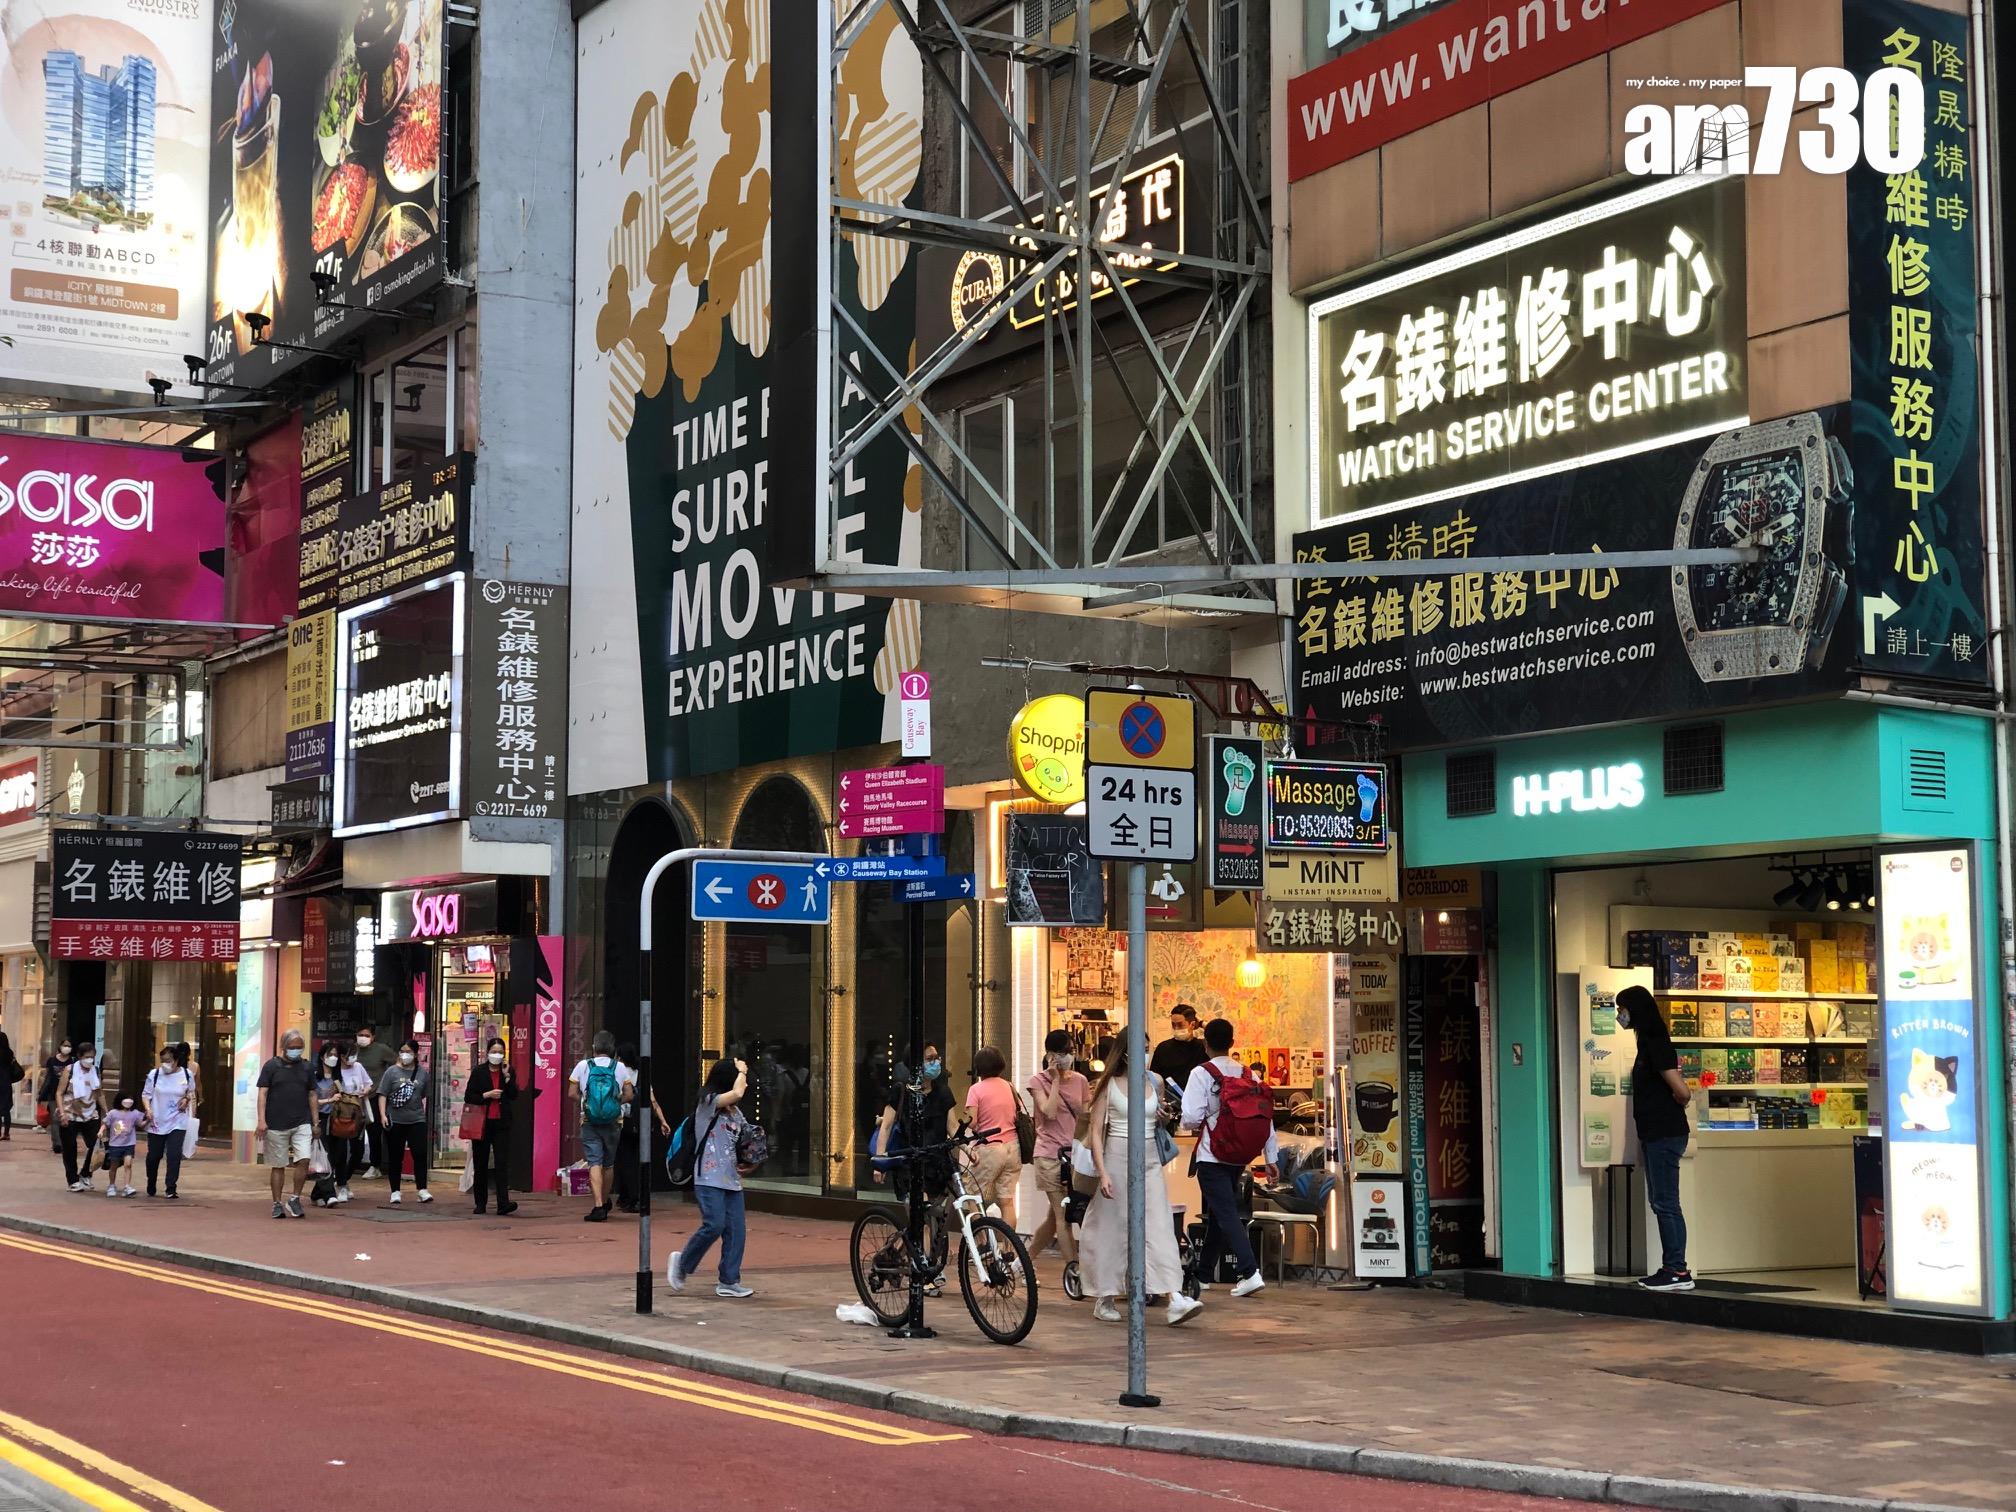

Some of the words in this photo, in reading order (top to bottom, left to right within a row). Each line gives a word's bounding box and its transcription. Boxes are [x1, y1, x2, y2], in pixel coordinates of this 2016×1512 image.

[215, 41, 238, 73] FJAKA
[1933, 40, 1969, 231] 隆晟精時
[100, 298, 148, 312] MIDTOWN
[961, 276, 993, 306] CUBA
[1882, 26, 1939, 583] 名維修服務中心
[1339, 225, 1718, 432] 名錶維修中心
[209, 324, 232, 364] 26/F
[673, 395, 748, 470] TIME
[1339, 429, 1436, 487] WATCH
[1447, 391, 1576, 460] SERVICE
[1588, 350, 1728, 423] CENTER
[31, 531, 100, 568] 莎莎
[0, 576, 39, 598] aking
[43, 575, 72, 600] life
[75, 579, 142, 604] beautiful
[508, 582, 554, 598] HÉRNLY
[1298, 543, 1620, 657] 名錶維修服務中心
[1301, 665, 1340, 688] Email
[1343, 655, 1408, 681] address:
[1415, 608, 1655, 667] info@bestwatchservice.com
[1886, 626, 1972, 662] 請上一樓
[669, 623, 865, 717] EXPERIENCE
[1341, 684, 1405, 709] Website:
[1420, 639, 1656, 697] www.bestwatchservice.com
[496, 606, 540, 801] 名錶維修服務中心
[904, 706, 916, 750] Causeway
[915, 719, 926, 737] Bay
[881, 779, 905, 787] Elizabeth
[905, 777, 927, 785] Stadium
[1101, 776, 1136, 802] 24
[1144, 779, 1182, 806] hrs
[1275, 774, 1356, 812] Massage
[491, 802, 548, 818] 2217-6699
[864, 803, 879, 811] Happy
[896, 800, 927, 808] Racecourse
[58, 833, 101, 845] HÉRNLY
[863, 825, 880, 833] Racing
[881, 823, 903, 831] Museum
[1109, 812, 1172, 849] 全日
[1218, 818, 1259, 845] Massage
[1355, 825, 1381, 840] 3/F
[196, 842, 217, 850] 2217
[218, 842, 239, 851] 6699
[61, 857, 236, 905] 名錶維修
[852, 870, 887, 878] Causeway
[888, 869, 902, 877] Bay
[903, 868, 928, 876] Station
[1218, 858, 1259, 880] 95320835
[1283, 888, 1321, 896] INSTANT
[1326, 888, 1382, 896] INSPIRATION
[1407, 879, 1469, 896] CORRIDOR
[1266, 907, 1402, 946] 名錶維修中心
[57, 936, 235, 958] 手袋維修護理
[1360, 974, 1388, 988] TODAY
[1355, 1004, 1362, 1016] A
[1363, 1004, 1390, 1017] DAMN
[1370, 1017, 1395, 1032] FINE
[1932, 1018, 1970, 1039] BROWN
[1353, 1034, 1397, 1055] COFFEE
[1438, 954, 1473, 1190] 名錶維修
[1409, 1071, 1419, 1146] INSPIRATION
[1416, 1071, 1425, 1122] INSTANT
